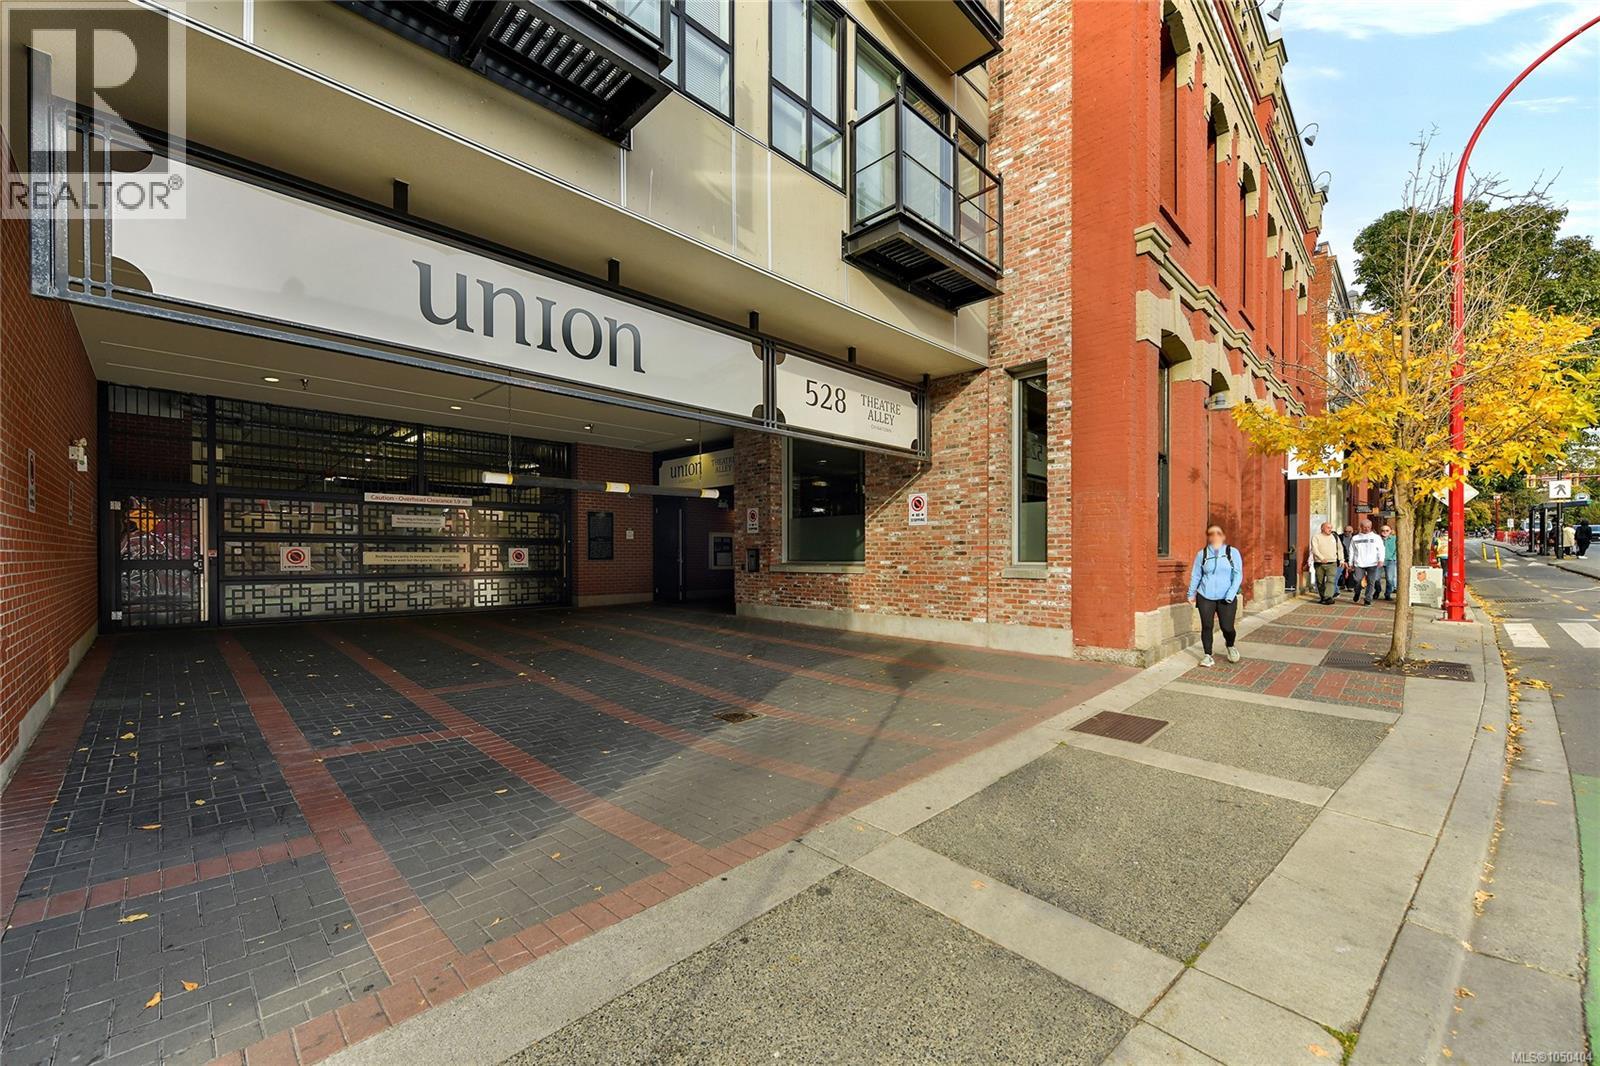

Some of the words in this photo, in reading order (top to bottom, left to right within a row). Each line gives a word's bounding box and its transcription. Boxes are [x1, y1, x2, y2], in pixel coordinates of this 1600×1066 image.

[805, 379, 847, 414] 528
[860, 393, 901, 416] THEATRE
[867, 409, 895, 426] ALLEY
